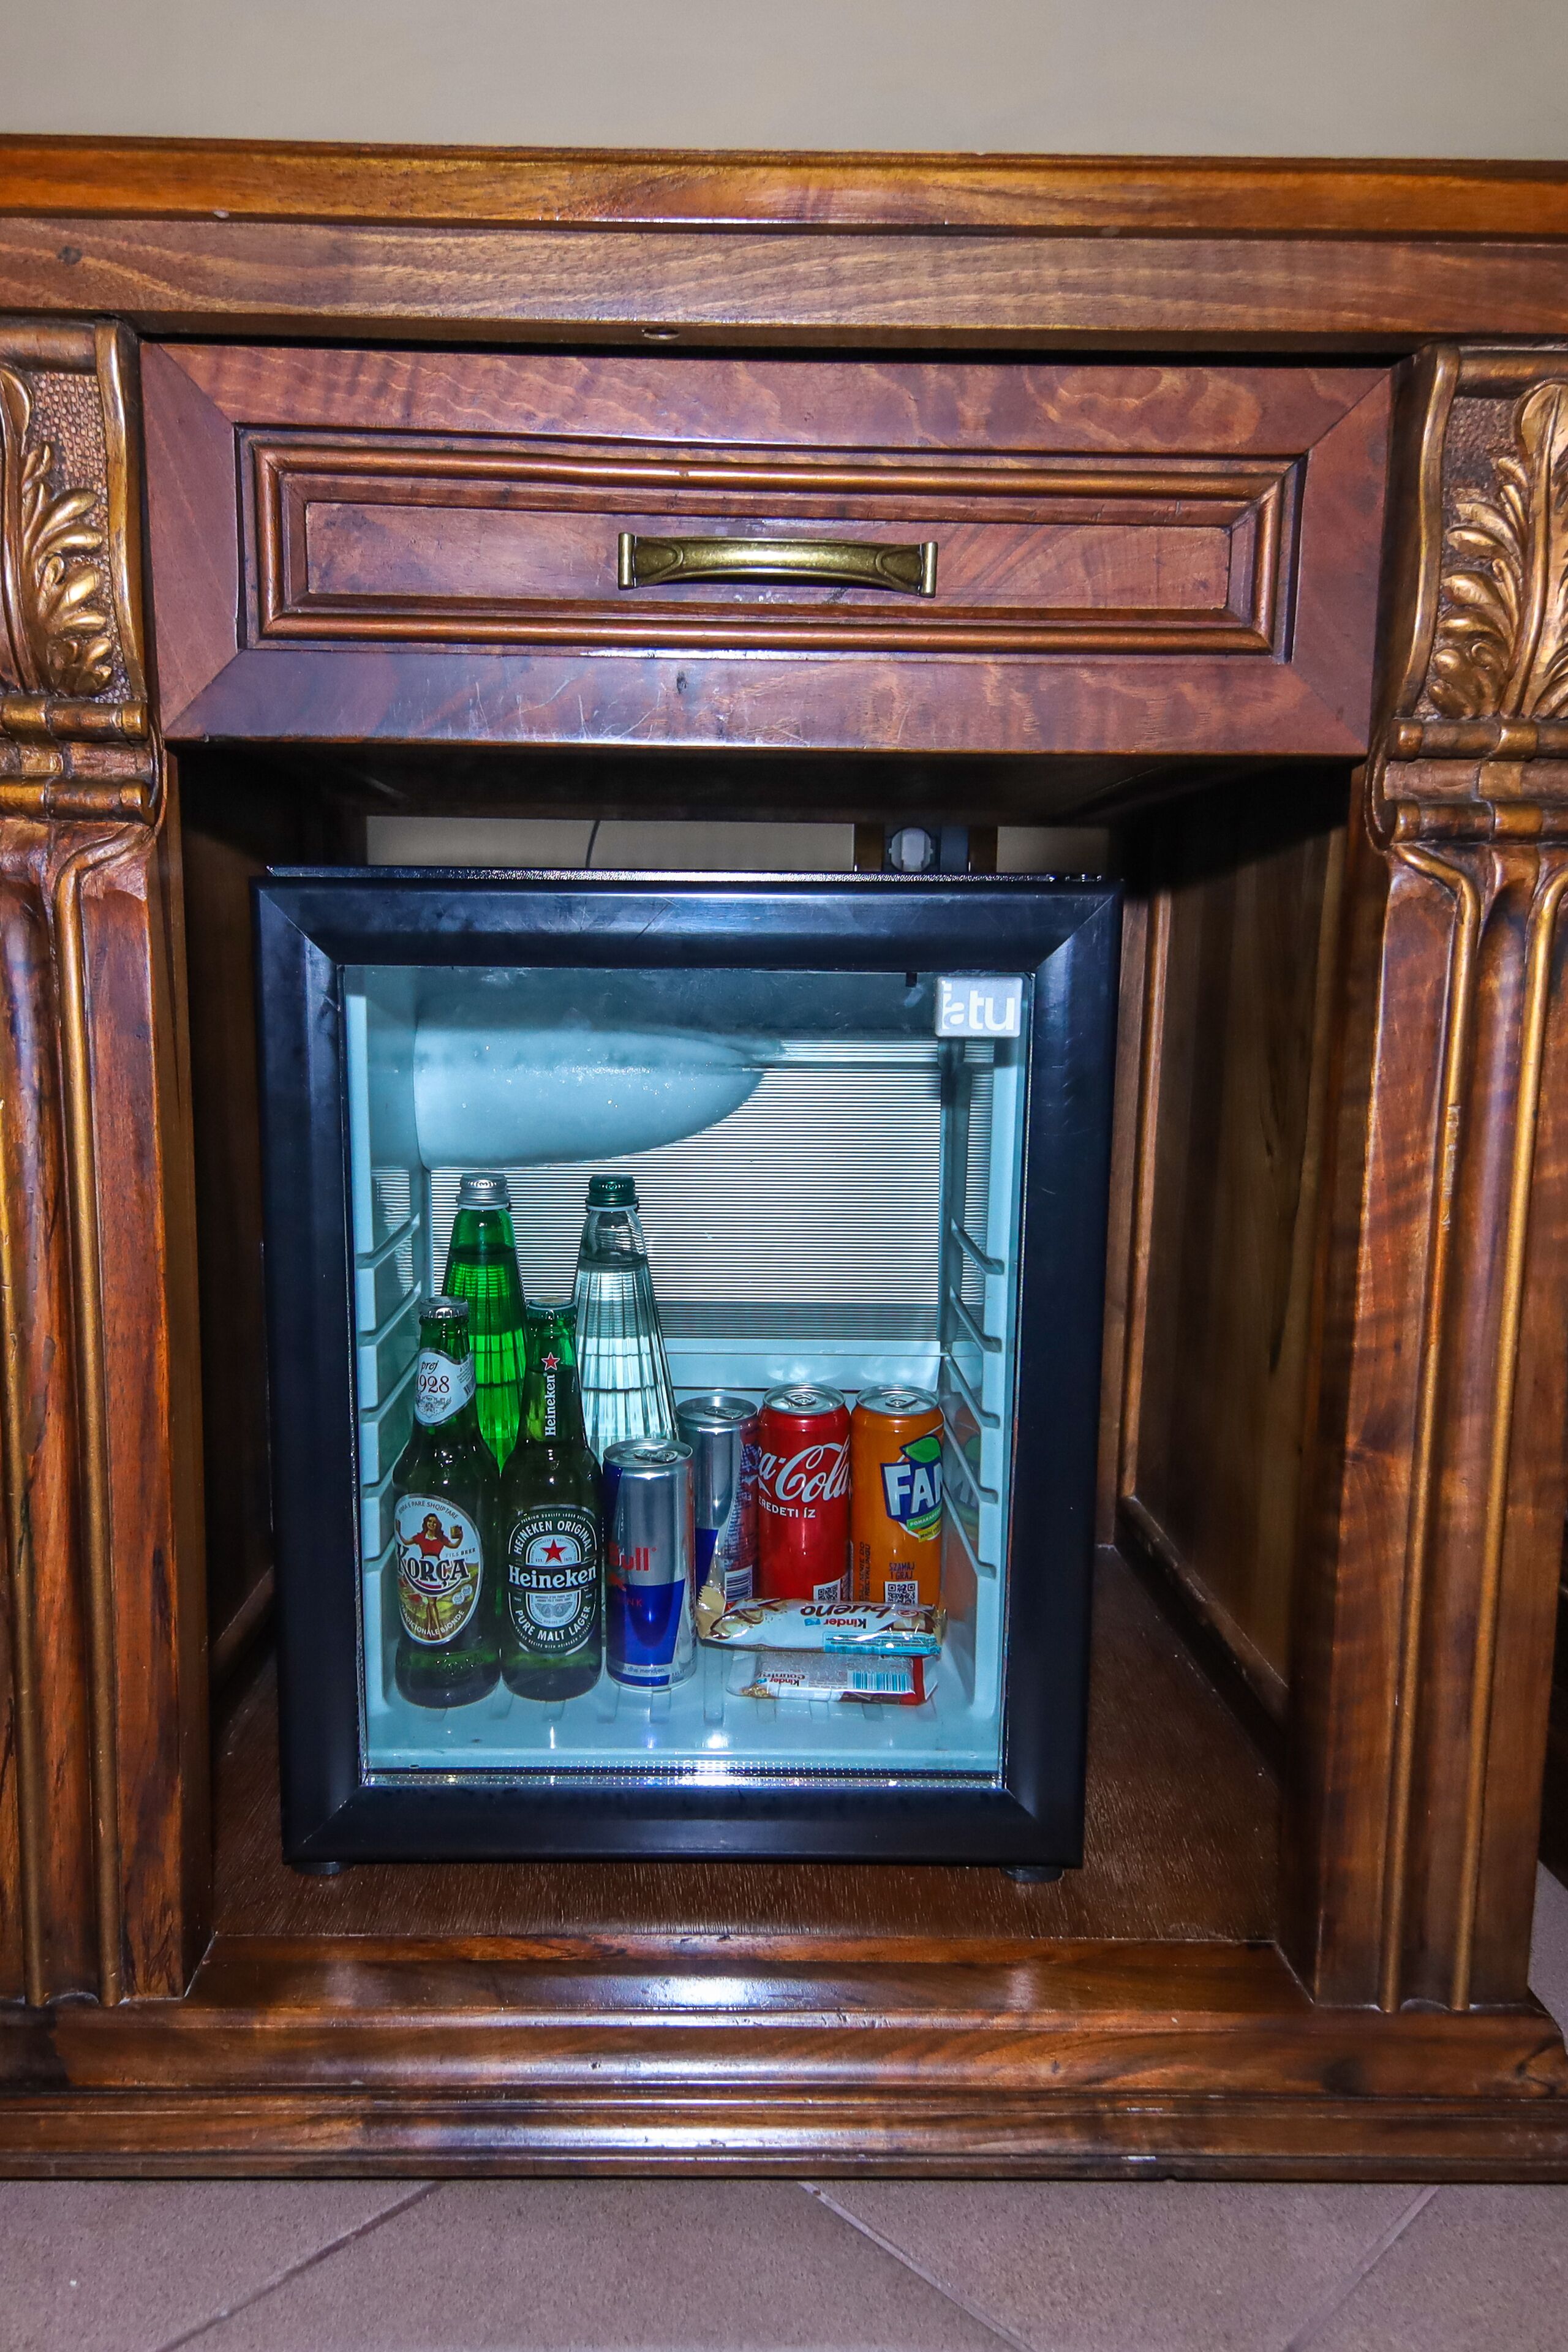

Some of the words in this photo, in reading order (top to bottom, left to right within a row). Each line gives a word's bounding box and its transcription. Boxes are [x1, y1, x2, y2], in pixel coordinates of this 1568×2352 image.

[545, 1374, 556, 1436] Heineken
[514, 1521, 552, 1555] HEINEKEN
[557, 1521, 592, 1552] ORIGINAL
[396, 1543, 470, 1588] KORÇA
[608, 1542, 649, 1571] Bull
[508, 1566, 597, 1588] Heineken
[440, 1610, 465, 1633] BJONDE
[515, 1610, 535, 1635] PURE
[537, 1630, 565, 1642] MALT
[568, 1606, 591, 1636] LAGER
[801, 1605, 891, 1618] bueno
